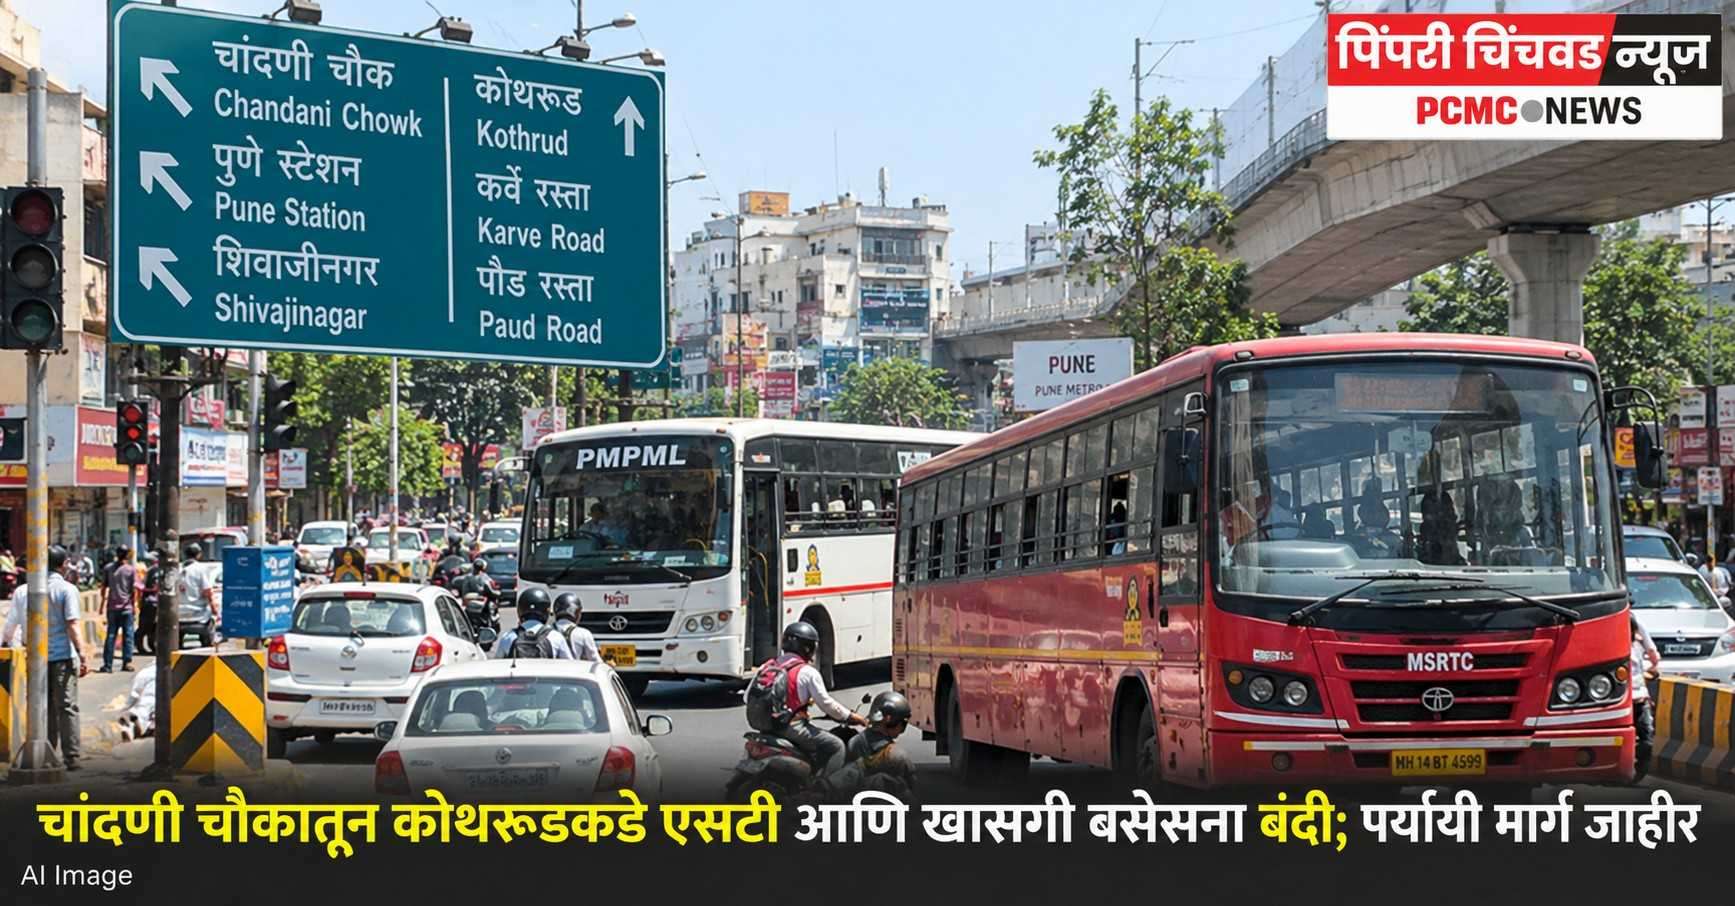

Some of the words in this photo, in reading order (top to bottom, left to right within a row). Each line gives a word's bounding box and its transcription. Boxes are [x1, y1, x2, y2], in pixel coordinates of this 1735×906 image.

[212, 34, 314, 81] चांदणी
[327, 43, 395, 90] चौक
[473, 66, 582, 116] कोथरूड
[214, 87, 331, 128] Chandani
[342, 102, 423, 138] Chowk
[477, 119, 568, 156] Kothrud
[212, 135, 263, 187] पुणे
[277, 140, 362, 186] स्टेशन
[475, 165, 523, 205] कर्वे
[534, 179, 591, 211] रस्ता
[215, 191, 276, 224] Pune
[284, 197, 365, 232] Station
[478, 216, 542, 248] Karve
[551, 223, 604, 253] Road
[212, 234, 380, 286] शिवाजीनगर
[476, 255, 527, 297] पौड
[538, 272, 594, 302] रस्ता
[215, 292, 367, 335] Shivajinagar
[480, 310, 535, 340] Paud
[547, 315, 602, 344] Road
[1049, 354, 1095, 375] PUNE
[1035, 385, 1062, 397] PUNE
[576, 444, 686, 470] PMPML
[1407, 652, 1474, 672] MSRTC
[1395, 755, 1414, 770] MH
[1417, 755, 1430, 769] 14
[1434, 754, 1449, 769] BT
[1452, 753, 1483, 769] 4599
